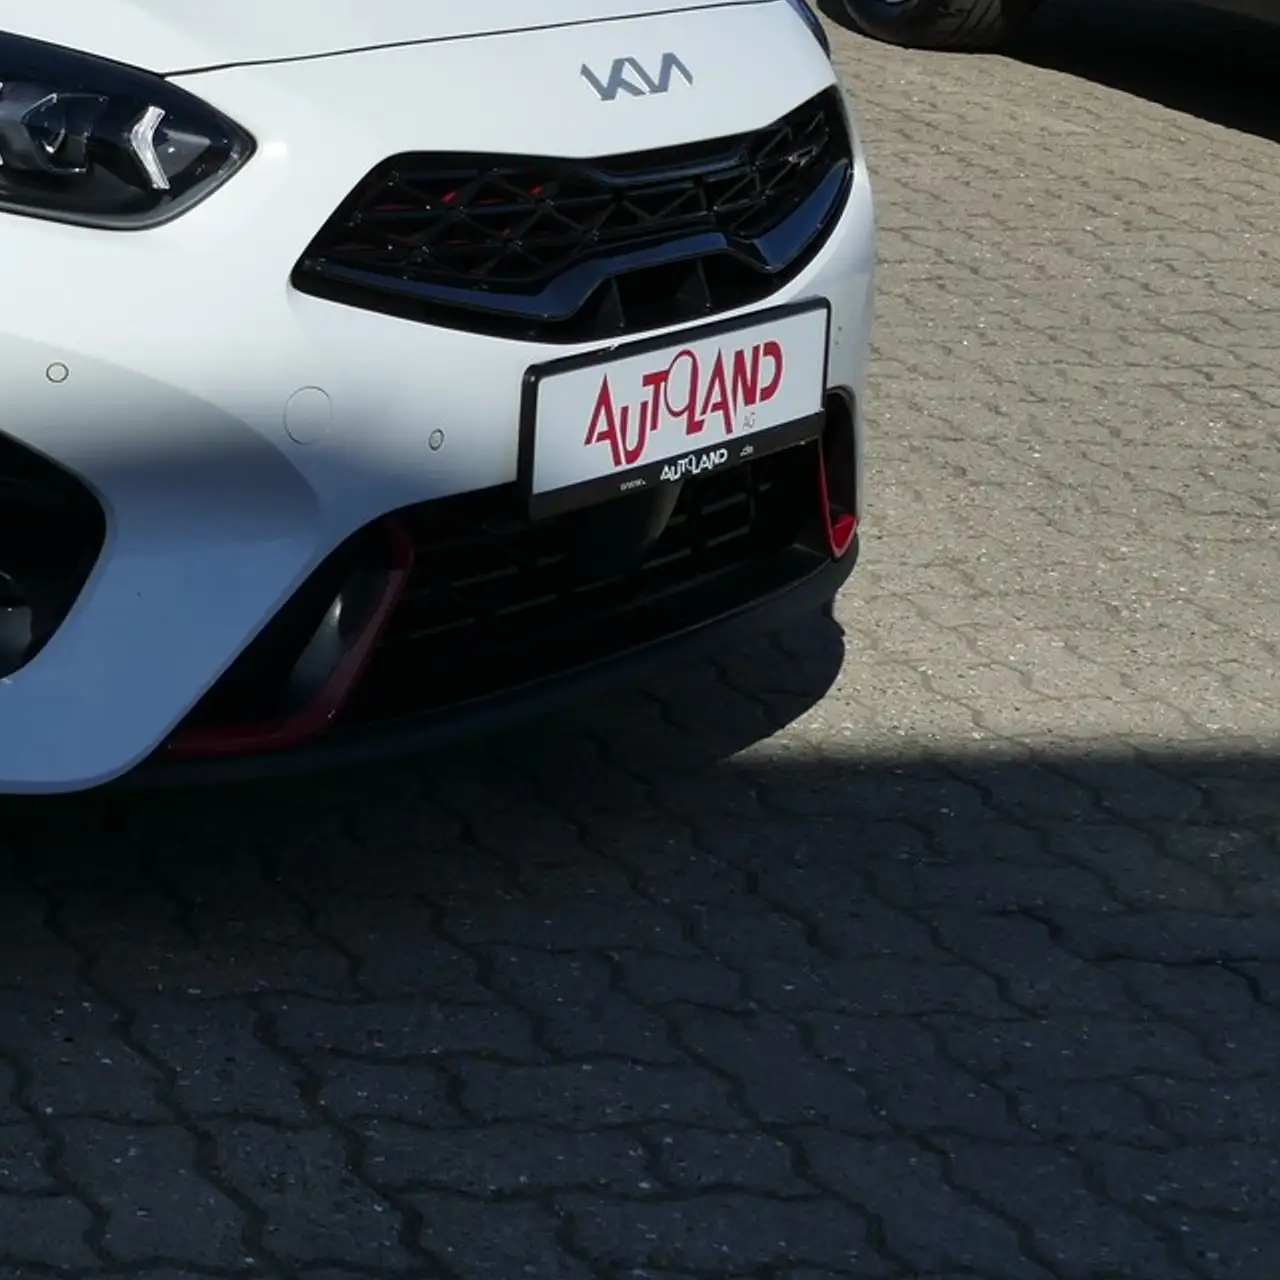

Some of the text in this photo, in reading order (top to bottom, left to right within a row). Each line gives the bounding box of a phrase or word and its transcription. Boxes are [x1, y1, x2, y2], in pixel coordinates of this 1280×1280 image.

[580, 51, 693, 102] KIA
[584, 340, 784, 467] AUTOLAND
[659, 447, 729, 483] AUTOLAND
